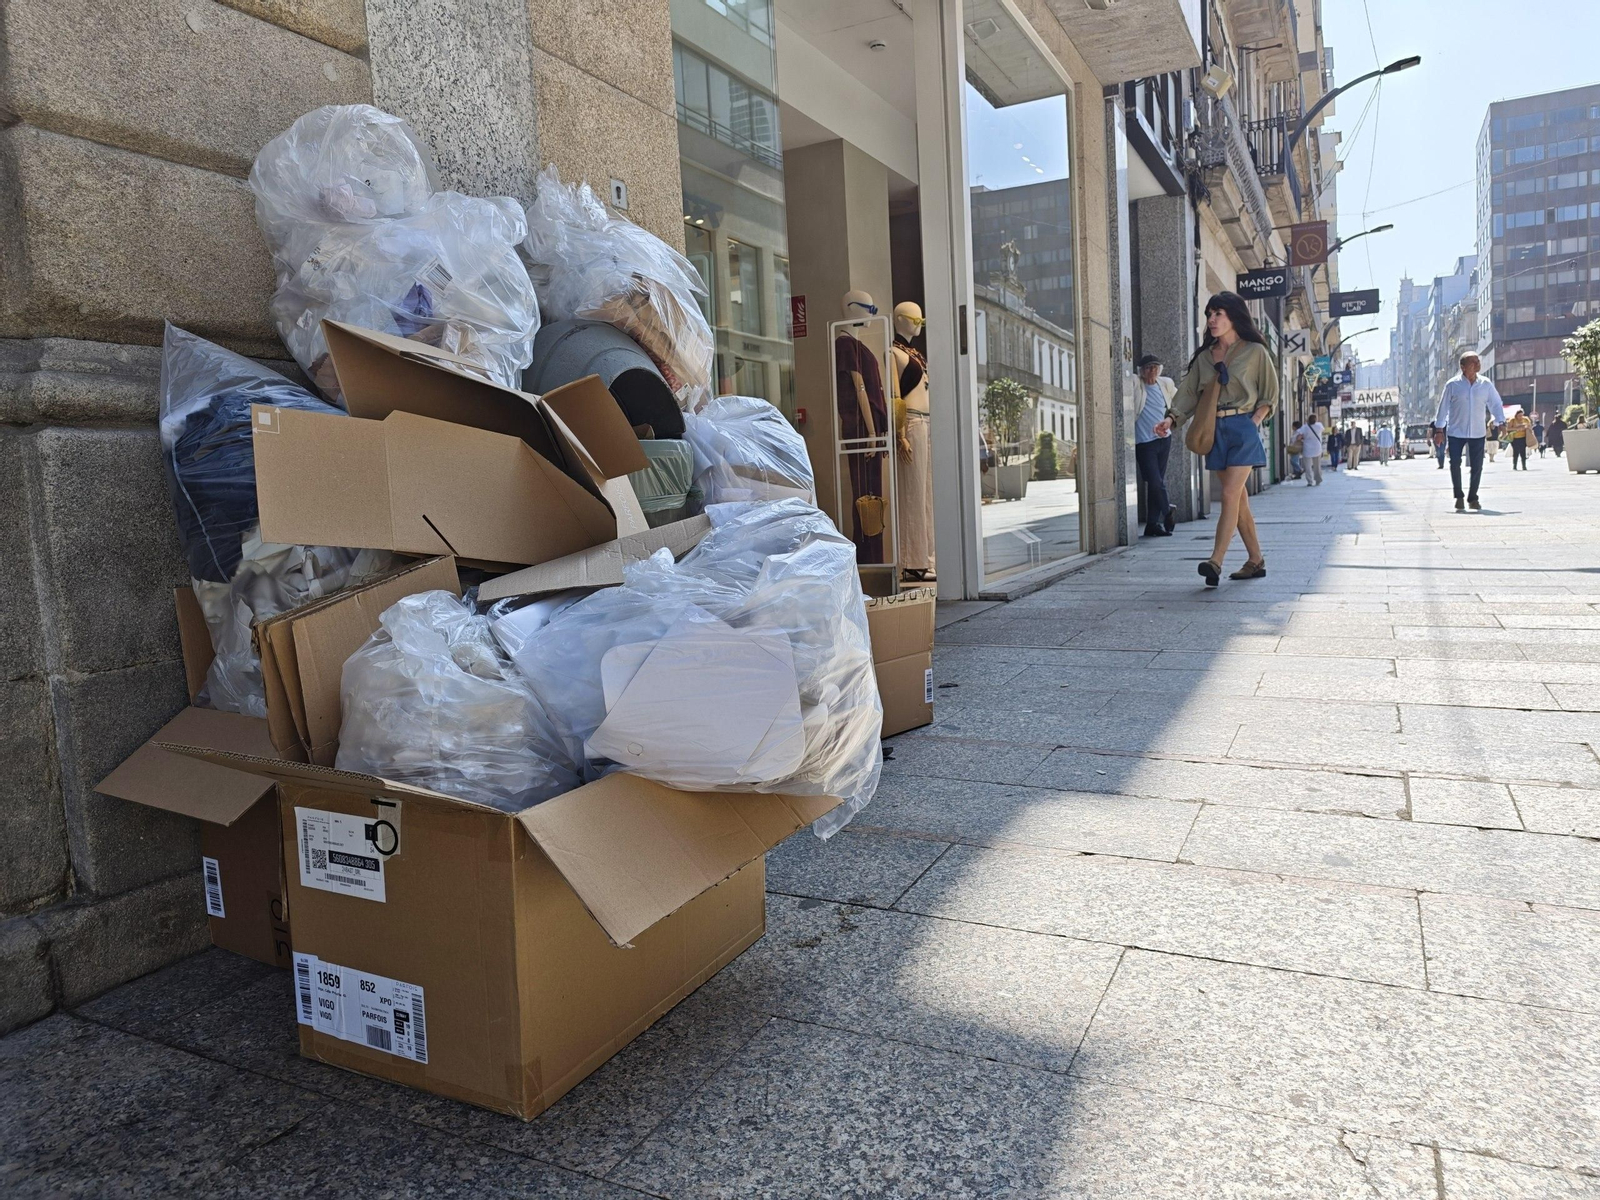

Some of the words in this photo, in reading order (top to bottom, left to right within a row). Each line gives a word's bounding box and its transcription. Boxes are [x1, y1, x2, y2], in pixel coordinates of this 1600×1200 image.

[1239, 275, 1284, 289] MANGO
[1357, 391, 1393, 403] ANKA
[317, 970, 340, 989] 1859
[360, 979, 376, 994] 852
[318, 997, 335, 1011] VIGO
[379, 996, 392, 1006] XPO
[319, 1010, 332, 1021] VIGO
[362, 1010, 388, 1024] PARFOIS
